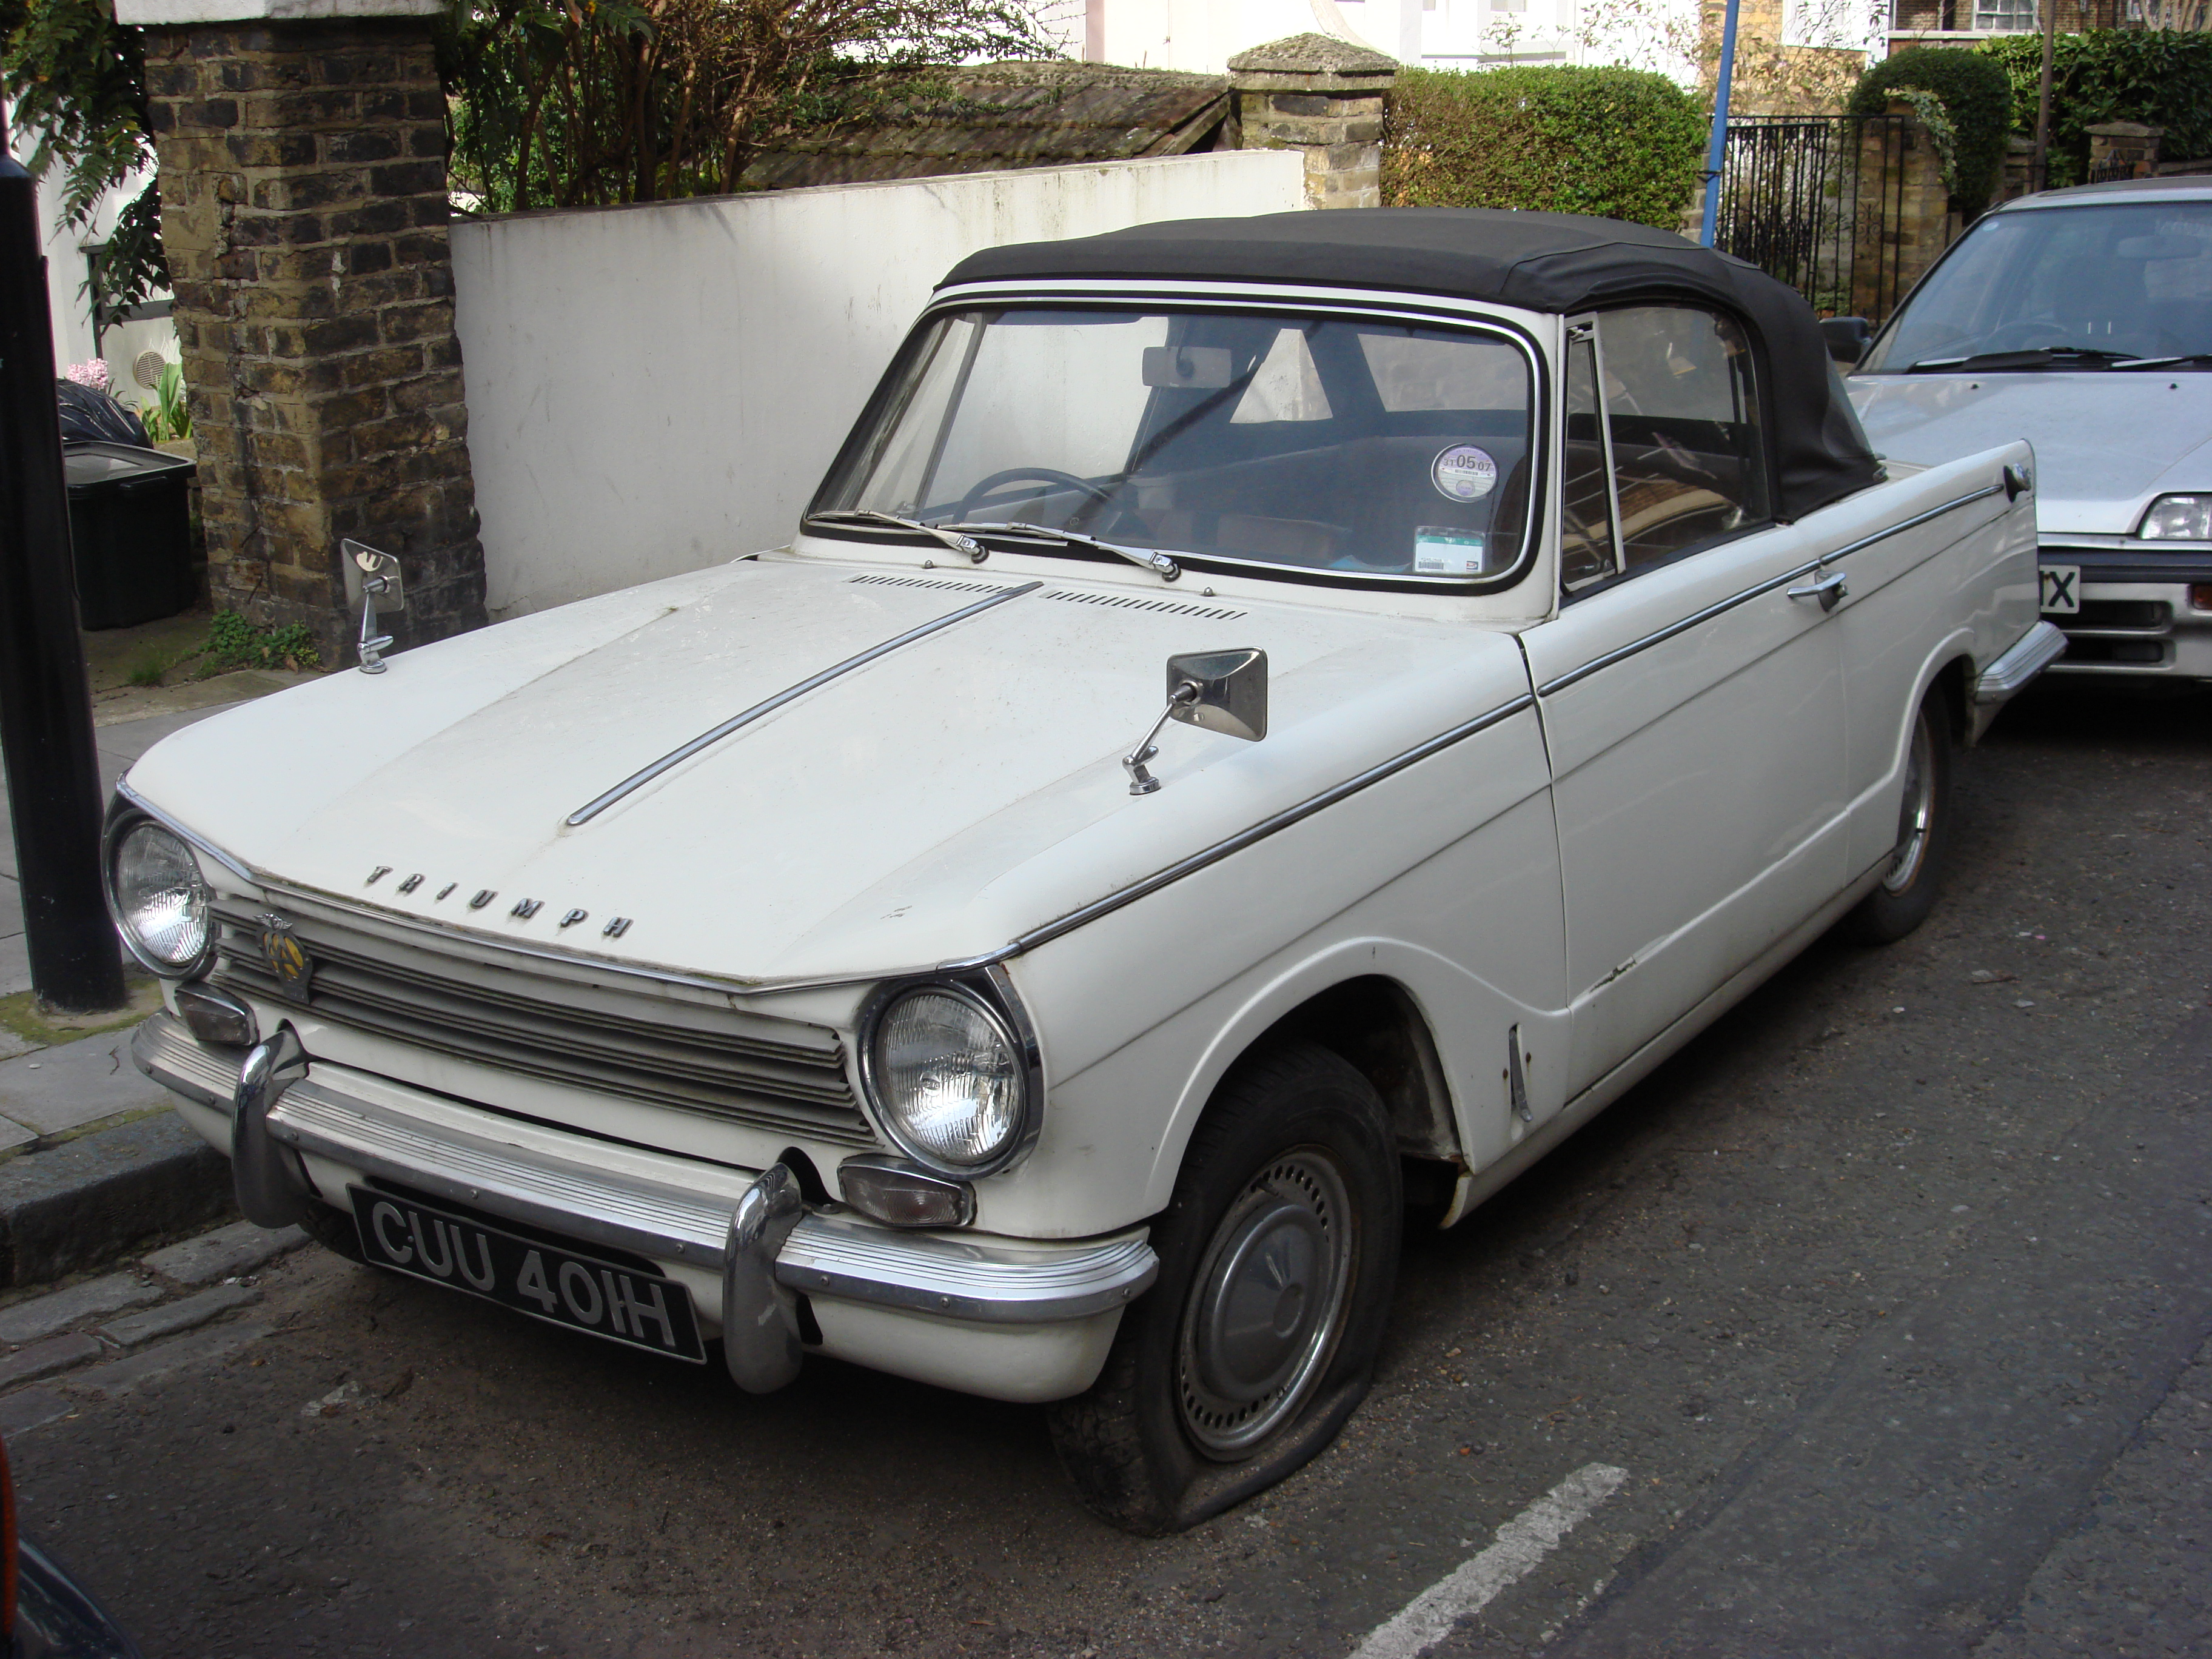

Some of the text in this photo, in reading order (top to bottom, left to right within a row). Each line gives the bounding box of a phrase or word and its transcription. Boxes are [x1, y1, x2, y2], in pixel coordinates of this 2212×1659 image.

[1456, 454, 1476, 469] 05
[1478, 461, 1492, 471] 07
[366, 865, 634, 937] TRIUMPH
[372, 1201, 676, 1347] CUU 401H
